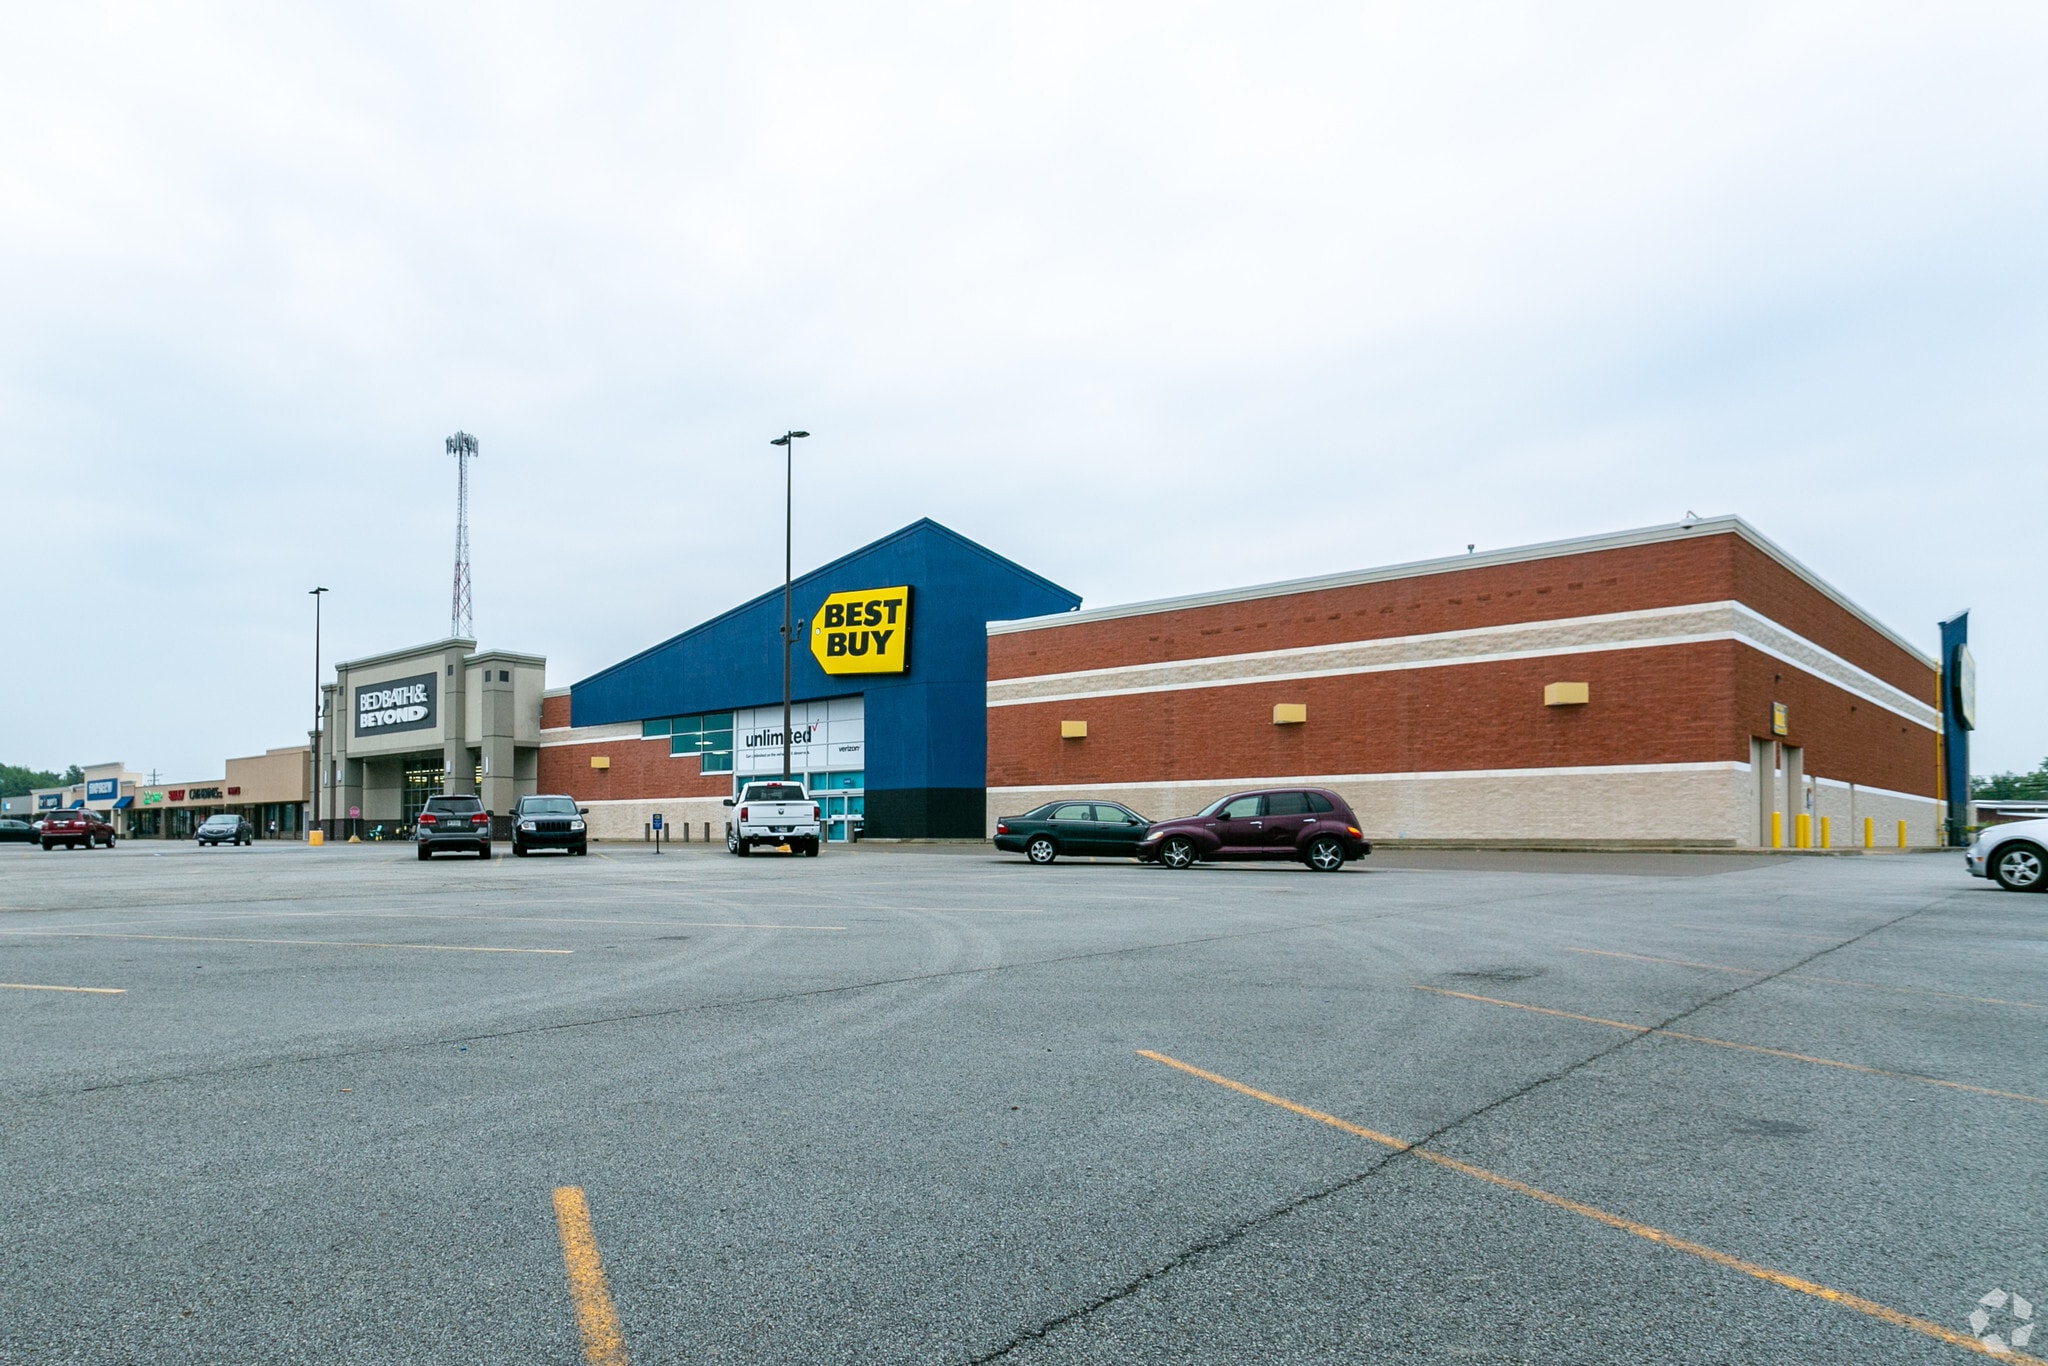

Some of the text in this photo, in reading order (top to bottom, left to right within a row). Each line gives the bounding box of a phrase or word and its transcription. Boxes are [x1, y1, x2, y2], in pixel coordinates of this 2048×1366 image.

[824, 599, 902, 628] BEST
[827, 630, 895, 656] BUY
[360, 683, 428, 712] BED BATH &
[360, 705, 428, 728] BEYOND
[746, 726, 811, 747] unlimted
[838, 744, 860, 753] verizon
